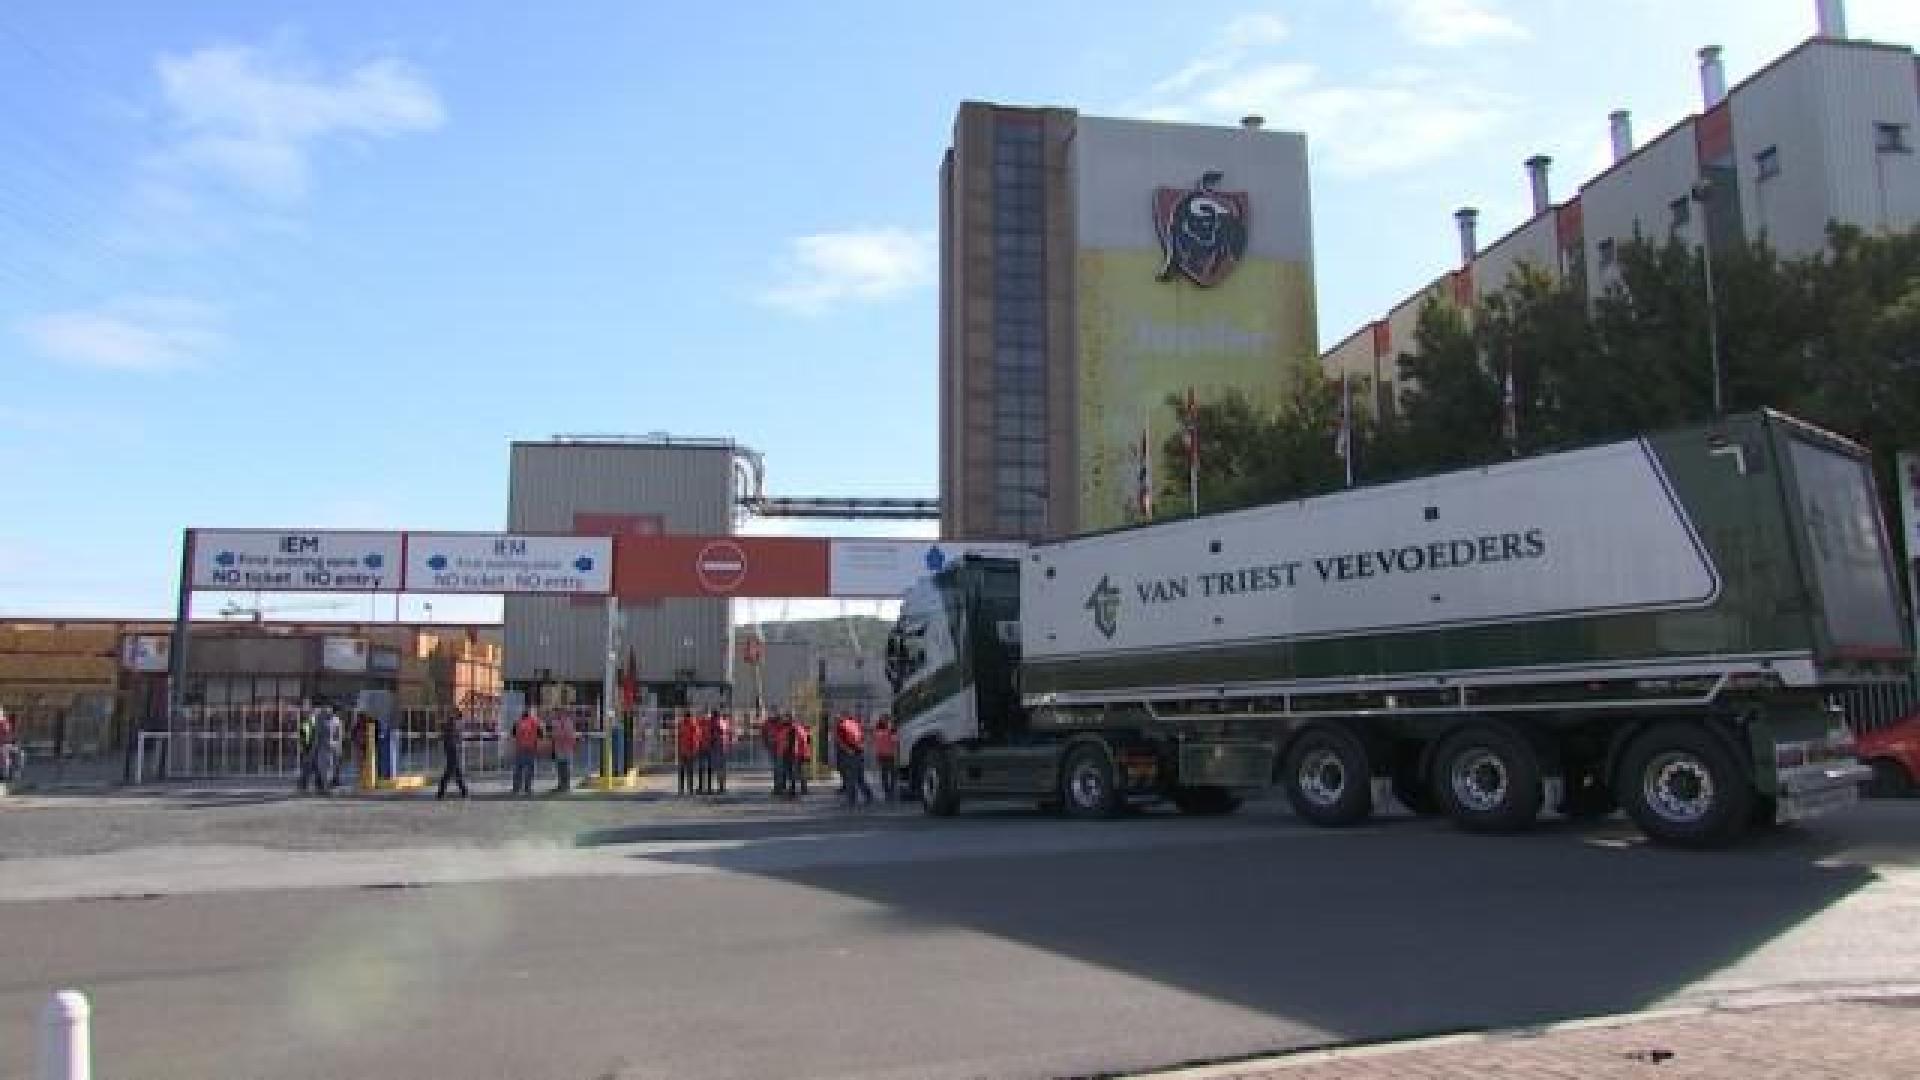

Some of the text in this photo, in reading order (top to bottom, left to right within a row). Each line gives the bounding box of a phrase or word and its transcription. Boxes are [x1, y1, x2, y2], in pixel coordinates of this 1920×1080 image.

[1136, 527, 1546, 605] VAN TRIEST VEEVOEDERS
[213, 569, 241, 583] NO
[303, 571, 331, 585] NO
[434, 573, 460, 587] NO
[515, 573, 542, 587] NO
